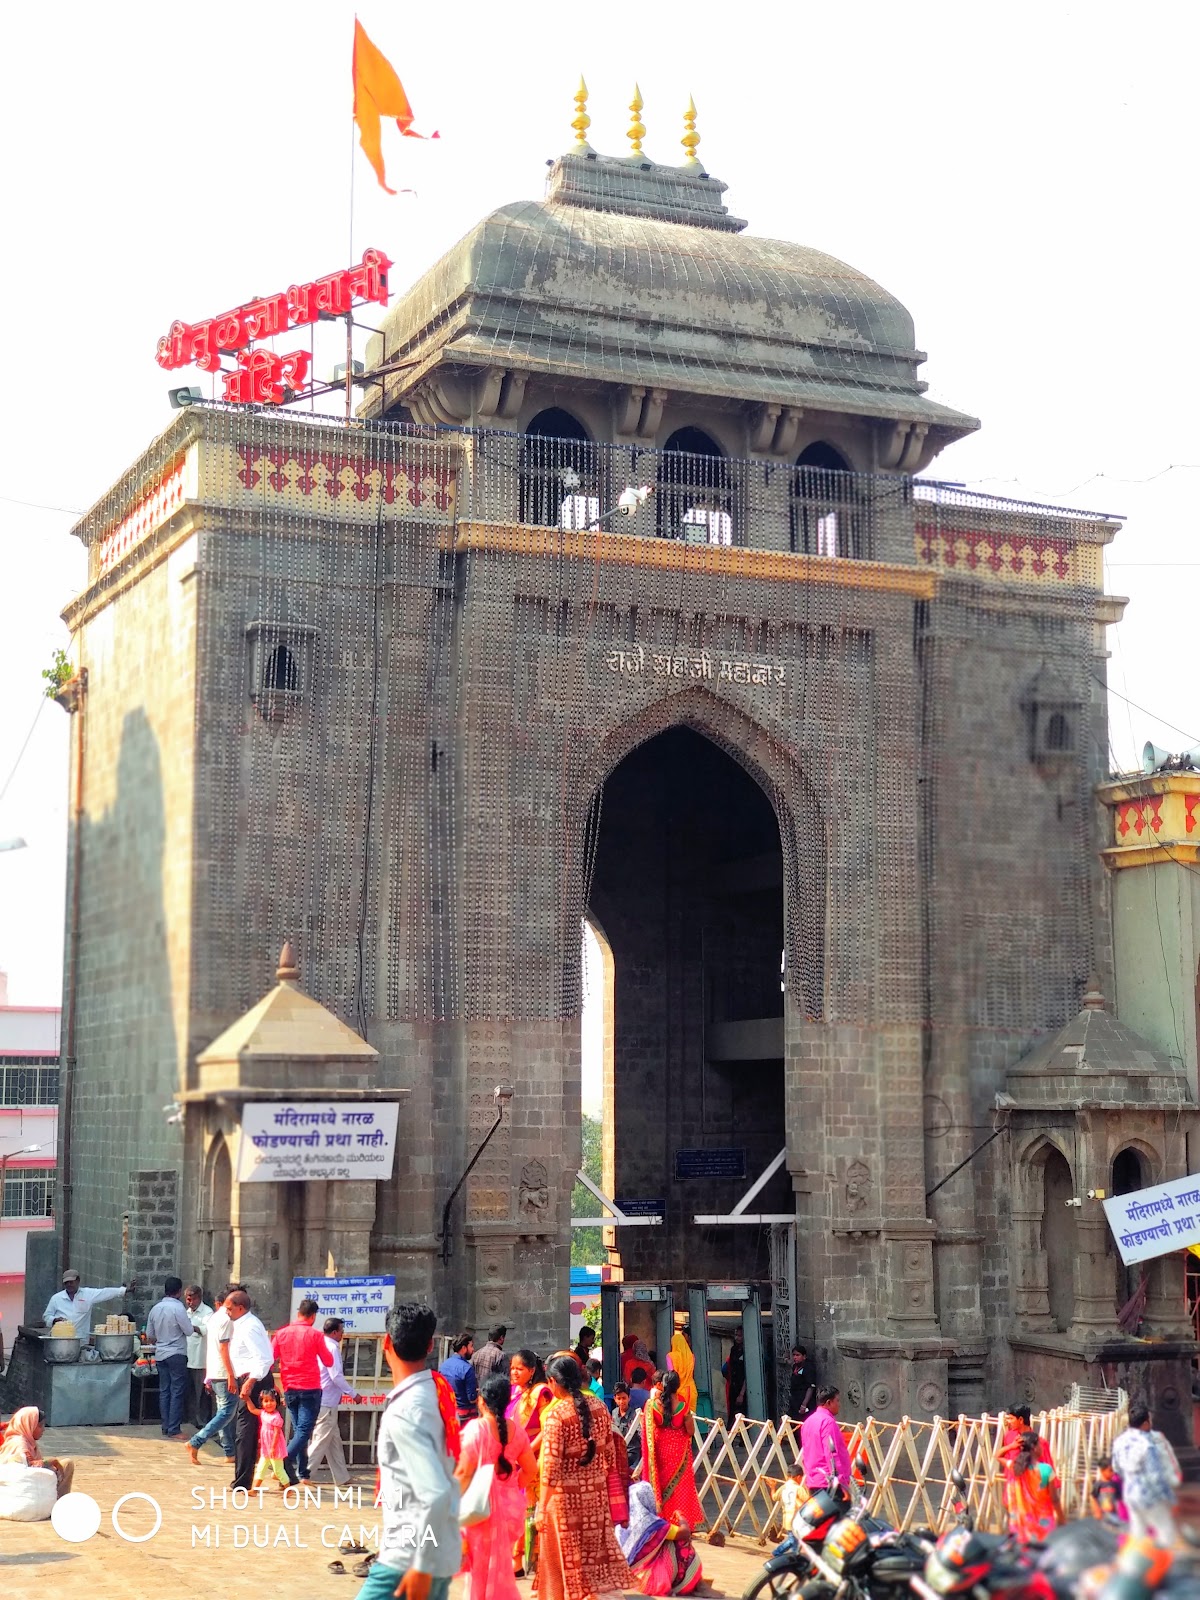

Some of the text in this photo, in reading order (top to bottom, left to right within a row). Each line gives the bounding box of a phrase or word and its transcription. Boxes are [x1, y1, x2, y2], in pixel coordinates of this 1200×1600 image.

[222, 348, 312, 404] मंदिर
[274, 1108, 375, 1126] मंदिरामध्ये नारळ
[252, 1130, 389, 1148] फोडण्याची प्रथा नाही.
[1125, 1193, 1175, 1221] मंदिरामध्ये
[1119, 1219, 1173, 1248] फोडण्याची
[1173, 1216, 1196, 1233] प्रथा
[305, 1290, 383, 1304] येथे चप्पल सोडू नये
[356, 1305, 390, 1314] करण्यात
